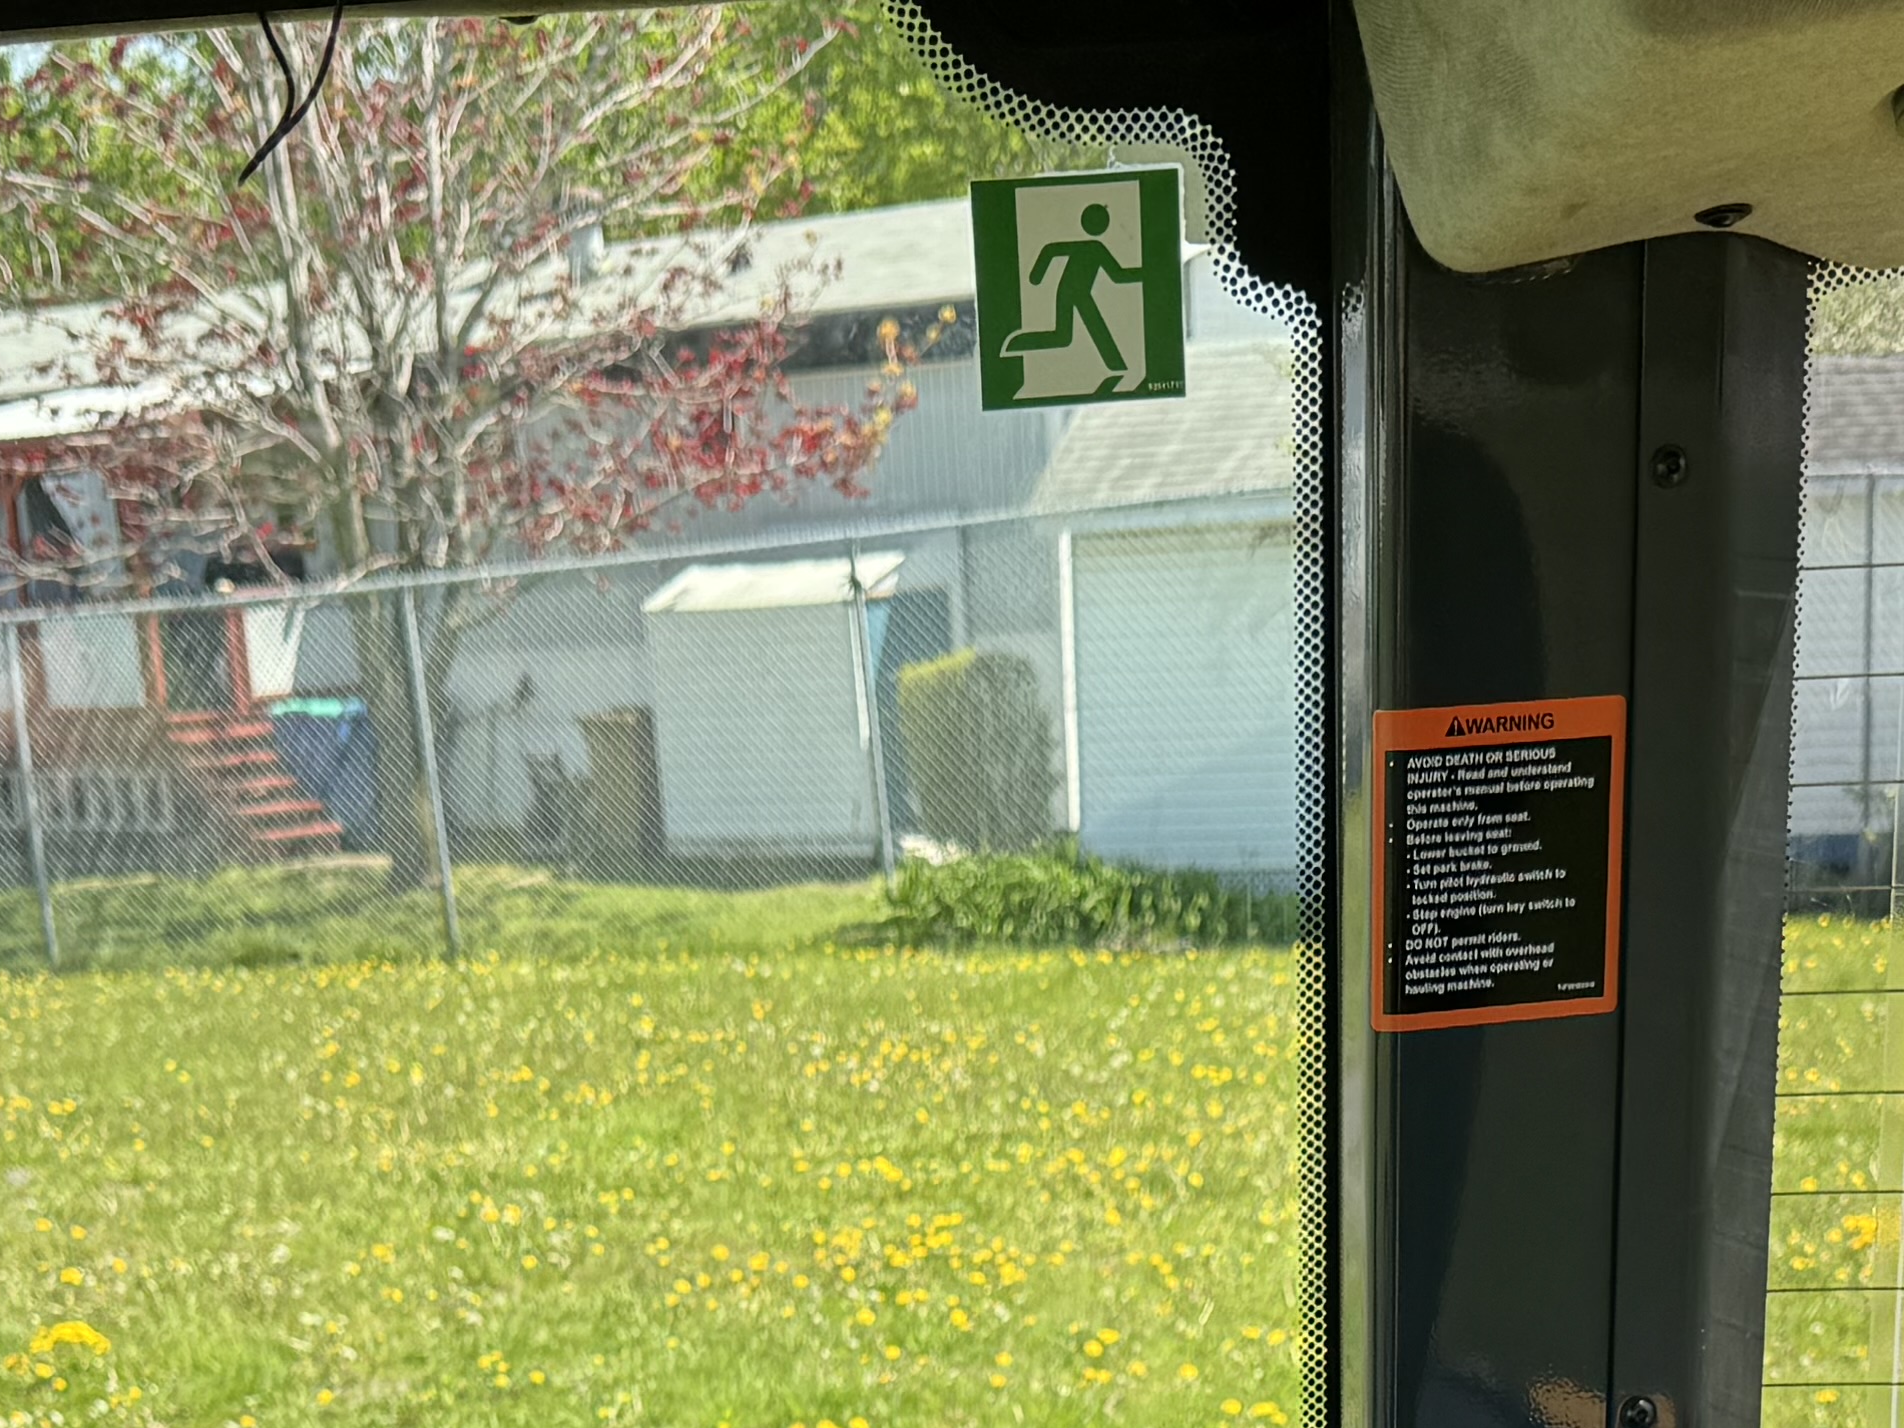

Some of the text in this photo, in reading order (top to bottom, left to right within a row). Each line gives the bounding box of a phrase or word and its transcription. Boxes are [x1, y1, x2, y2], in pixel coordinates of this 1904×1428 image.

[1465, 712, 1554, 735] WARNING
[1407, 747, 1555, 769] AVOID DEATH OR SERIOUS
[1407, 770, 1448, 784] INJURY
[1457, 768, 1484, 781] Read
[1487, 766, 1507, 778] and
[1510, 761, 1571, 776] understand
[1406, 775, 1594, 801] operator's manual before operating
[1406, 799, 1478, 815] this machine.
[1406, 810, 1531, 831] Operate only from seat.
[1406, 832, 1441, 845] Before
[1444, 829, 1482, 844] leaving
[1413, 840, 1542, 859] Lower bucket to ground.
[1413, 859, 1492, 875] Set park brake.
[1413, 868, 1565, 890] Turn pilot hydraulic switch to
[1412, 888, 1496, 905] locked position.
[1412, 897, 1575, 921] Stop engine (turn key switch to
[1405, 930, 1521, 950] DO NOT permit riders.
[1405, 942, 1554, 965] Avoid contact with overhead
[1405, 957, 1553, 980] obstacles when operating or
[1405, 977, 1494, 996] hauling machine.
